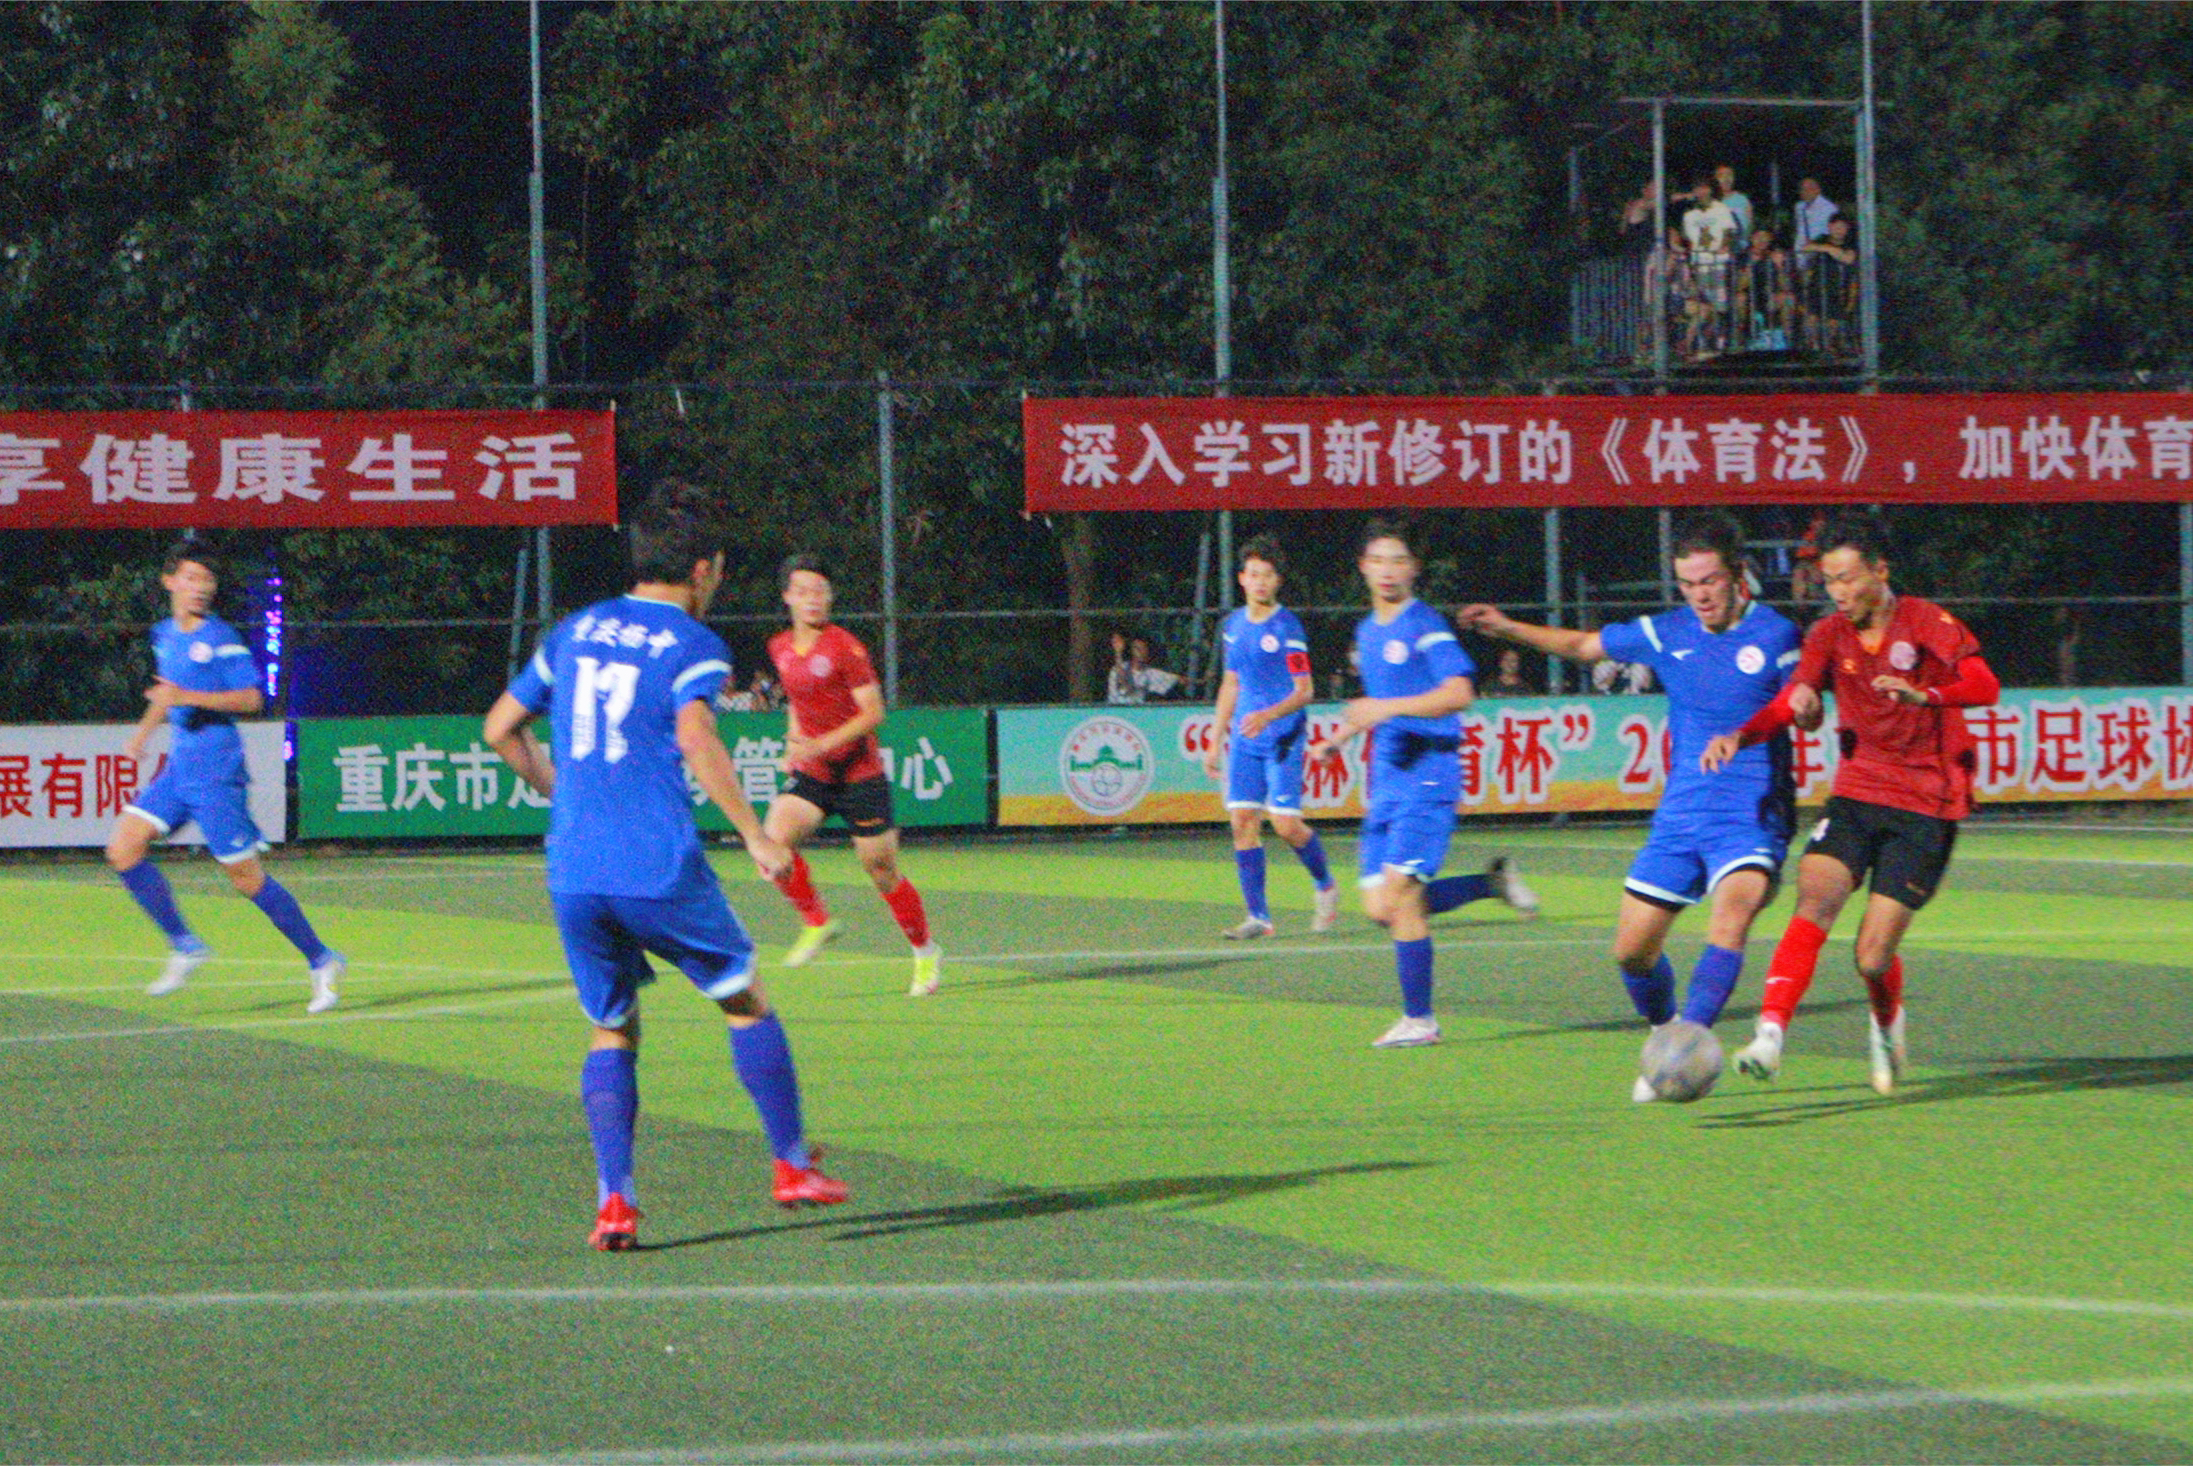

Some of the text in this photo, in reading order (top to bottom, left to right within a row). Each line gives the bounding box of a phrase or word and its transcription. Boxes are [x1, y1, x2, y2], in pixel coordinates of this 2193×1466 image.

[0, 433, 582, 504] 享健康生活
